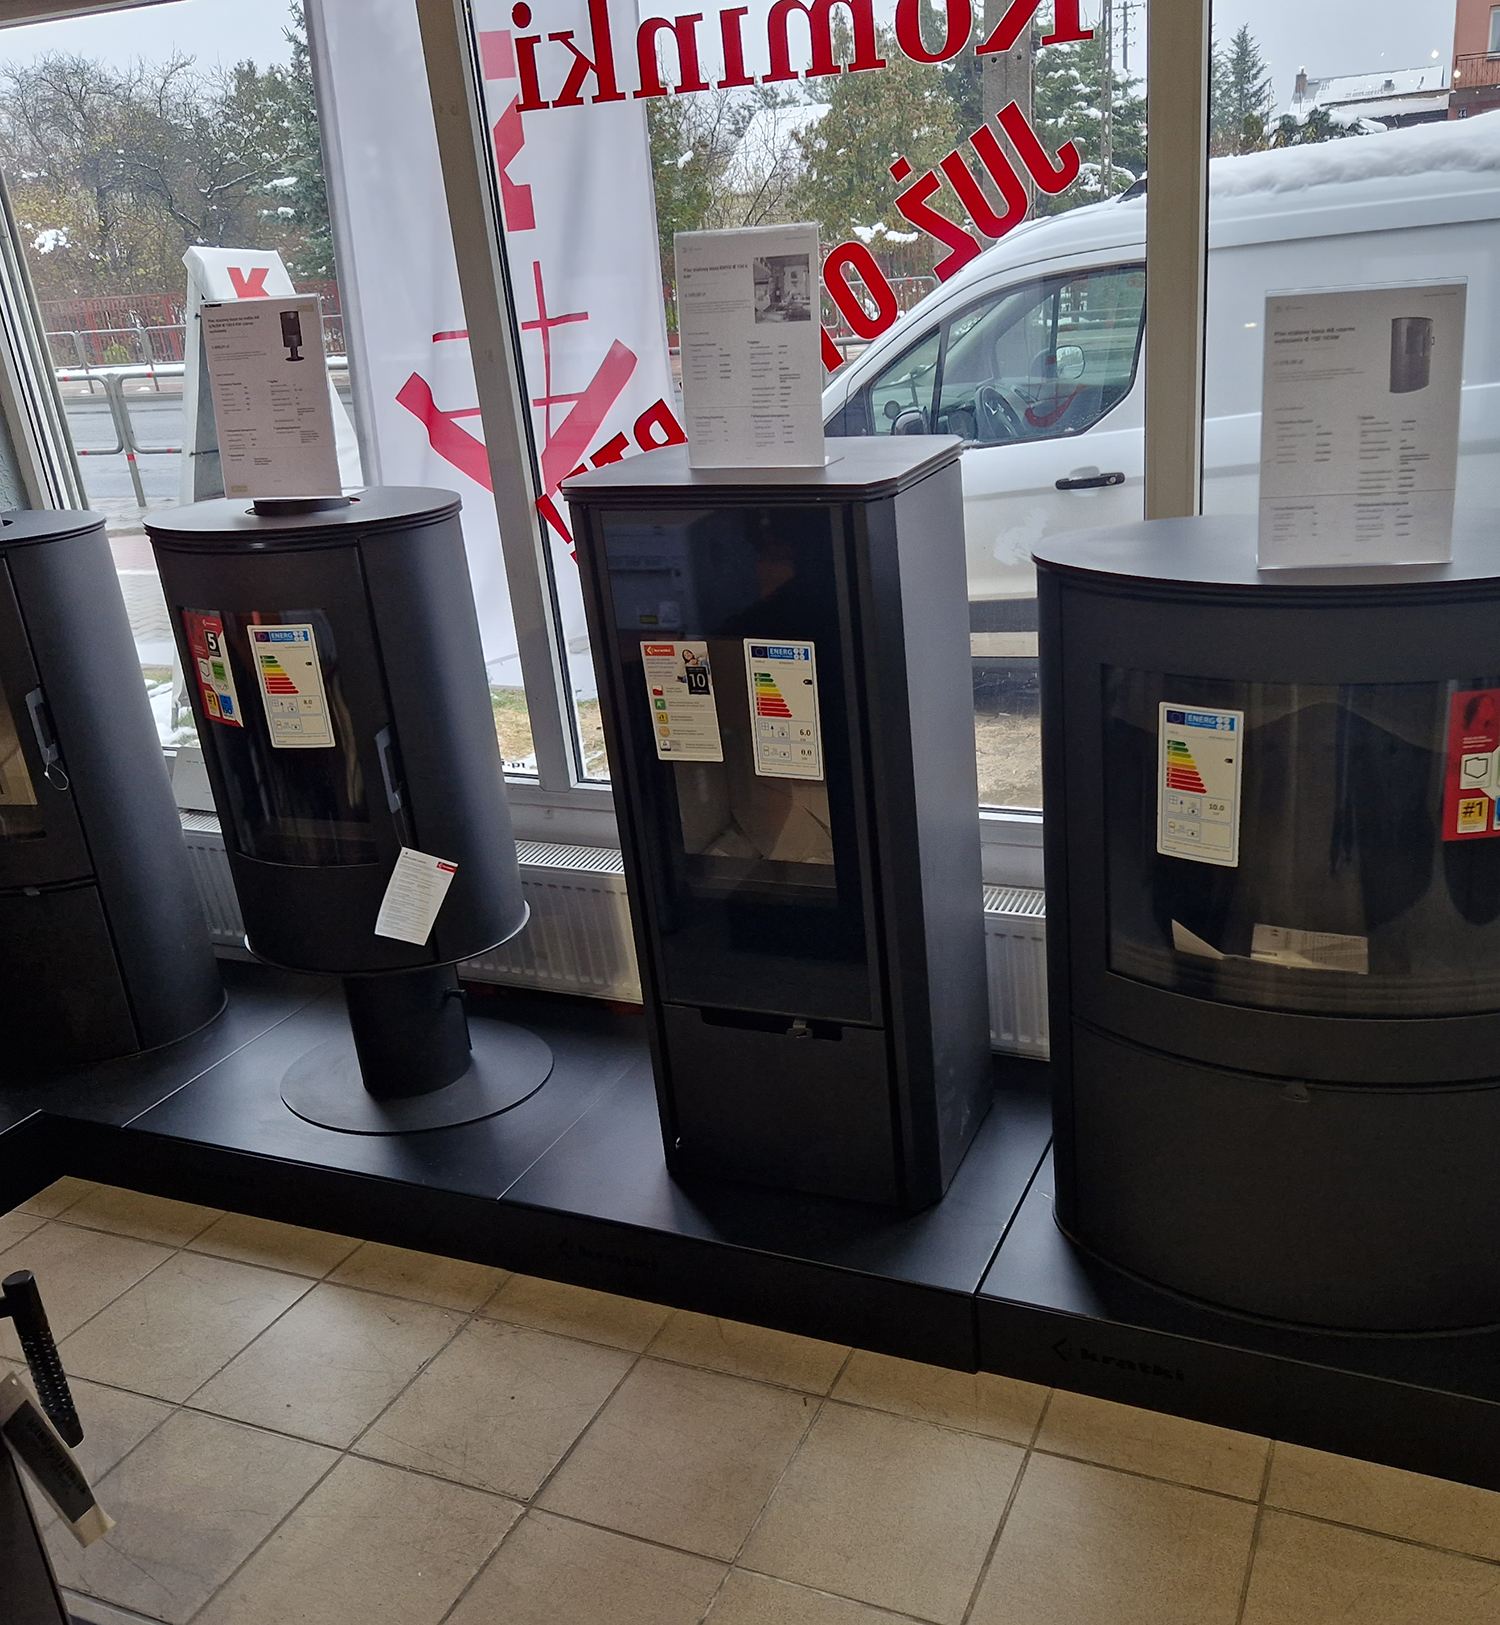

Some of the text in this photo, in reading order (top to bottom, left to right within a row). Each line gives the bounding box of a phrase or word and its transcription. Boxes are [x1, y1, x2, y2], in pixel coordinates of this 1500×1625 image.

[207, 636, 217, 650] 5
[769, 647, 793, 656] ENERG
[688, 673, 706, 688] 10
[1187, 714, 1216, 725] ENERG
[799, 729, 811, 737] 6.0
[1208, 803, 1225, 812] 10.0
[1462, 801, 1484, 818] #1
